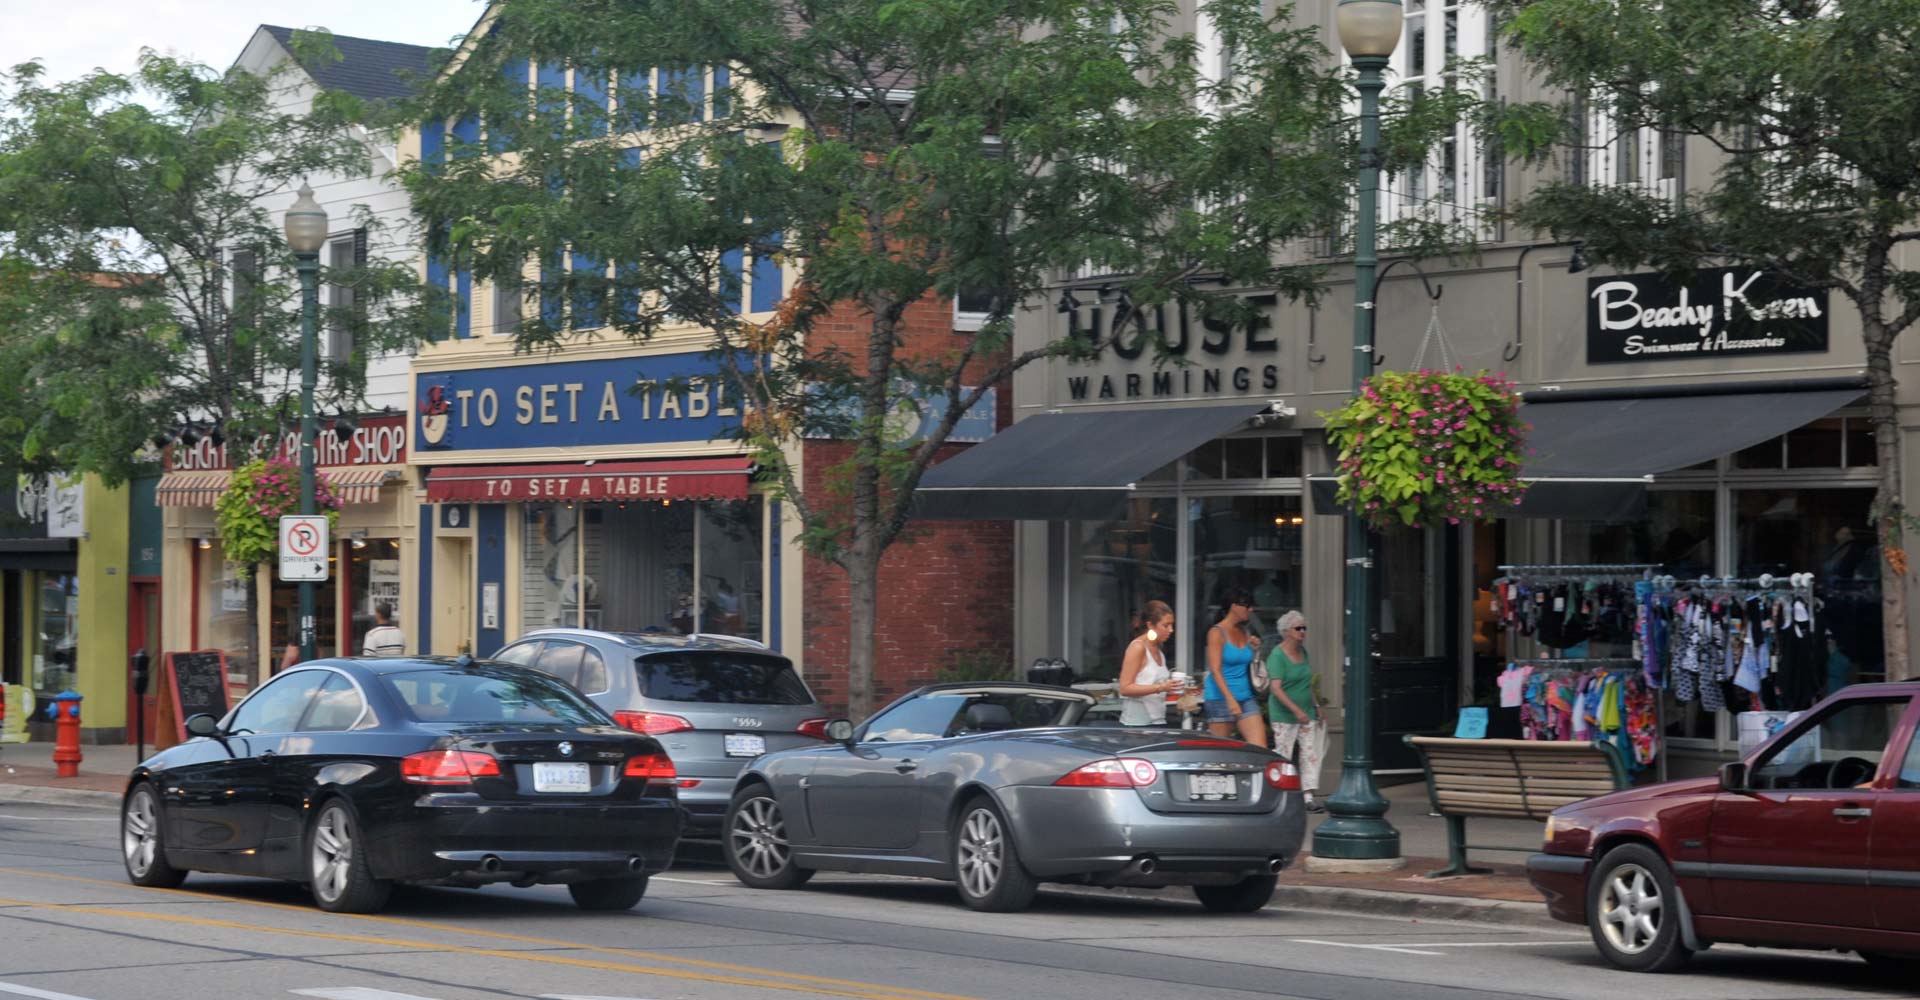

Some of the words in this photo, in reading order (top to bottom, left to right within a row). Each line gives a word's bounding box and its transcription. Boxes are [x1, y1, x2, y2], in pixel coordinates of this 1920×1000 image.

[1591, 280, 1714, 336] Beachy
[1723, 270, 1823, 321] Keen
[1068, 294, 1278, 361] HOUSE
[1713, 330, 1786, 350] Accessories
[1069, 364, 1278, 399] WARMINGS
[456, 387, 499, 427] TO
[515, 383, 583, 424] SET
[597, 381, 621, 421] A
[353, 425, 405, 464] SHOP
[486, 480, 512, 496] TO
[529, 478, 569, 496] SET
[580, 478, 591, 495] A
[604, 476, 669, 495] TABLE
